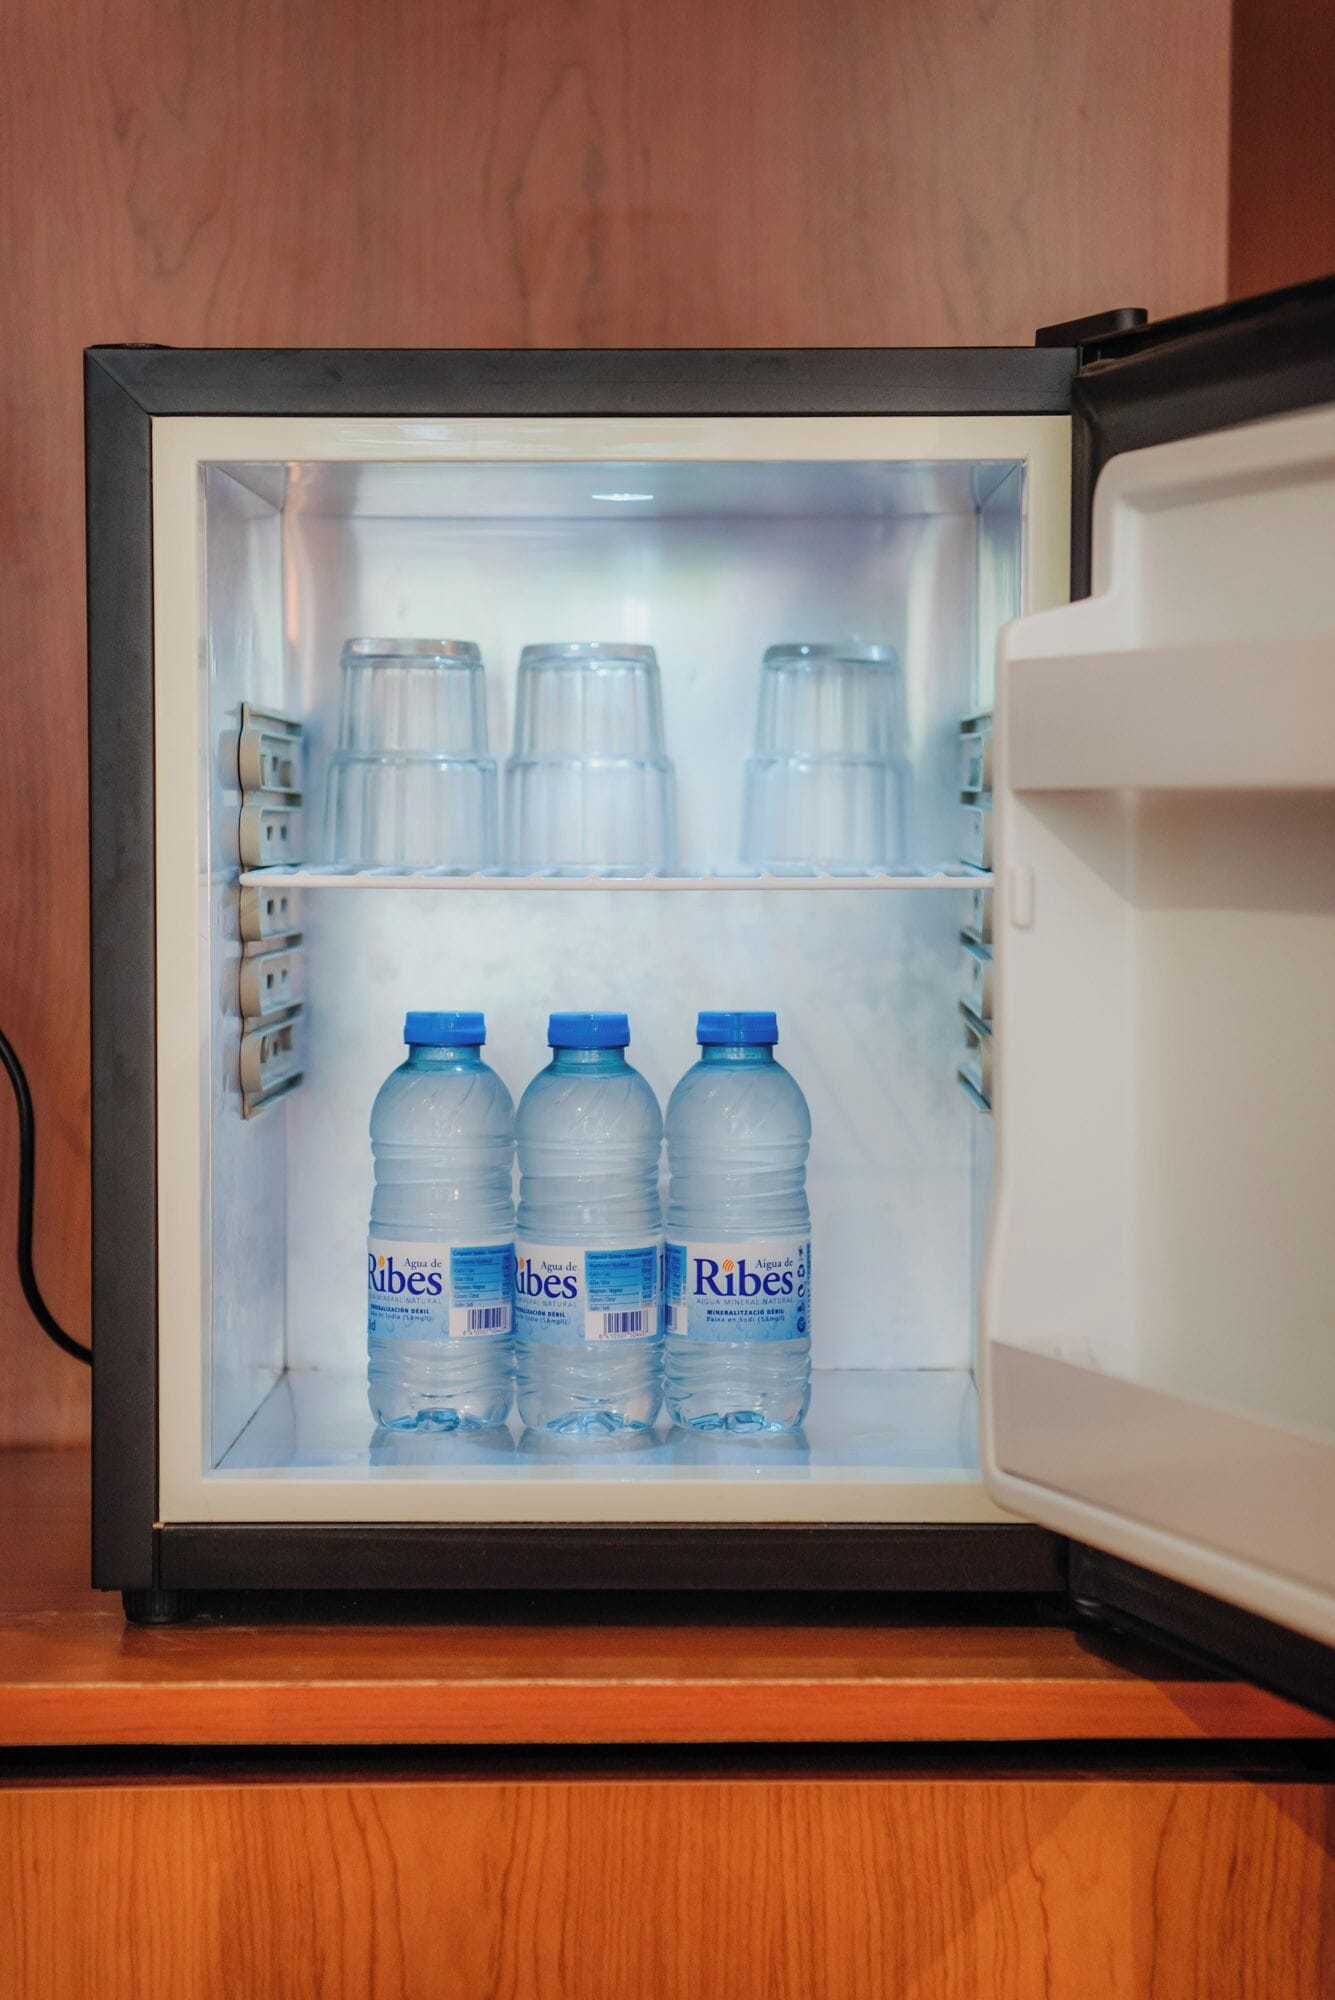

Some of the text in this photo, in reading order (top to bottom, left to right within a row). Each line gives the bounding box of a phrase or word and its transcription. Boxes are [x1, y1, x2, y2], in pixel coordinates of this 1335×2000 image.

[404, 1258, 442, 1270] Agua de
[540, 1261, 563, 1273] Agua
[565, 1262, 577, 1271] de
[755, 1257, 793, 1271] Aigua de
[368, 1253, 442, 1296] Ribes
[692, 1257, 793, 1297] Ribes
[406, 1297, 442, 1305] NATURAL
[543, 1300, 577, 1308] NATURAL
[697, 1298, 720, 1306] AIGUA
[724, 1298, 760, 1306] MINERAL
[370, 1303, 409, 1314] RALIZACIÓN
[707, 1308, 765, 1316] MINERALITZACIÓ
